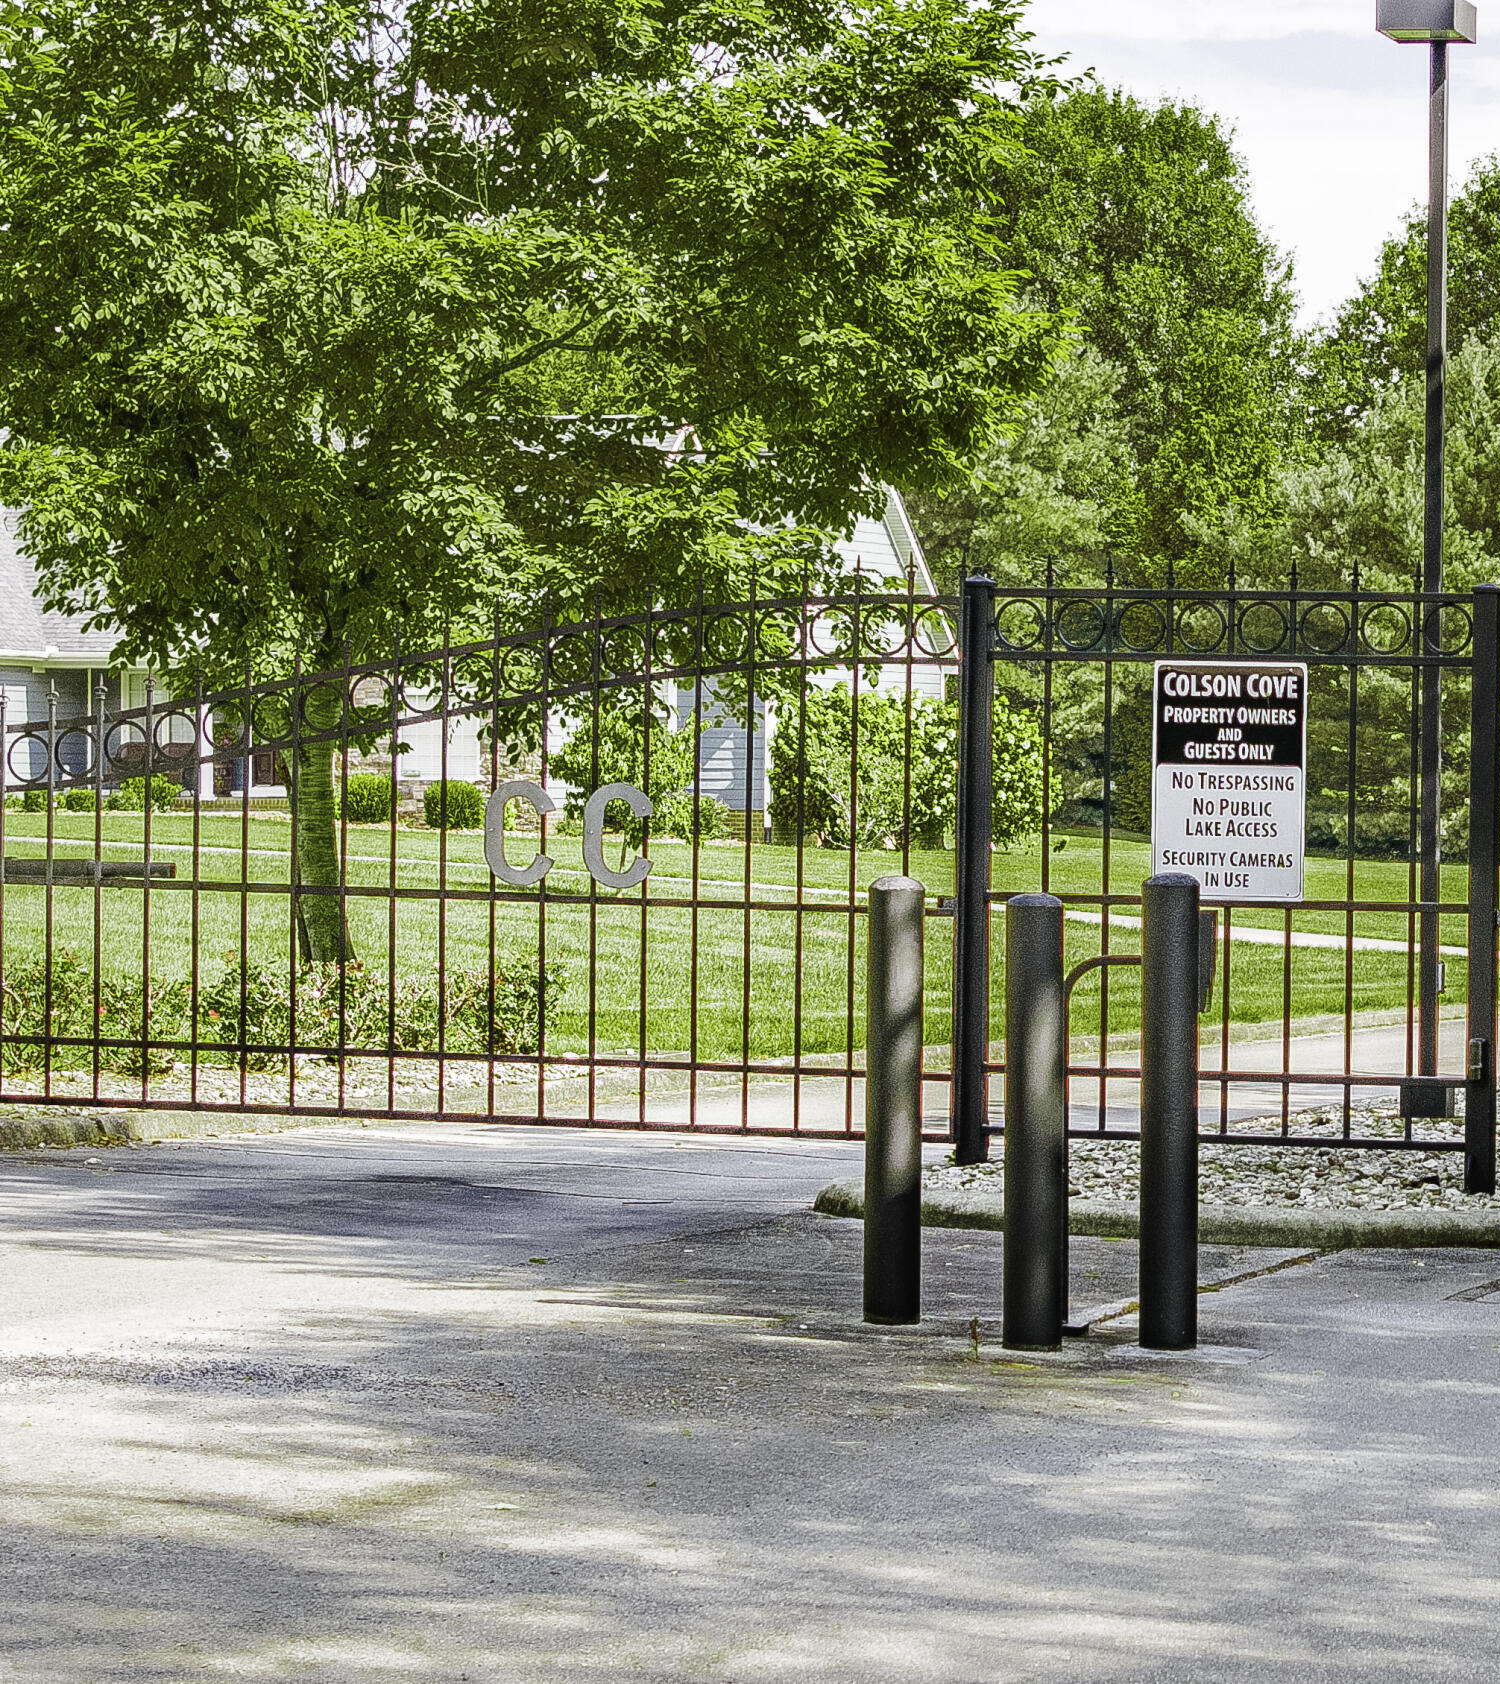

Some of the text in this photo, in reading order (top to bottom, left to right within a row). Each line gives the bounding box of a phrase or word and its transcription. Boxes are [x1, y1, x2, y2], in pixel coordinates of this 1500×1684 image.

[1163, 672, 1298, 699] COLSON COVE
[1164, 705, 1297, 725] PROPERTY OWNERS
[1217, 728, 1242, 741] AND
[1184, 741, 1274, 760] GUESTS ONLY
[1198, 772, 1295, 791] TRESPASSING
[1219, 798, 1272, 817] PUBLIC
[1185, 818, 1278, 838] LAKE ACCESS
[1162, 850, 1293, 868] SECURITY CAMERAS
[1205, 871, 1250, 887] IN USE
